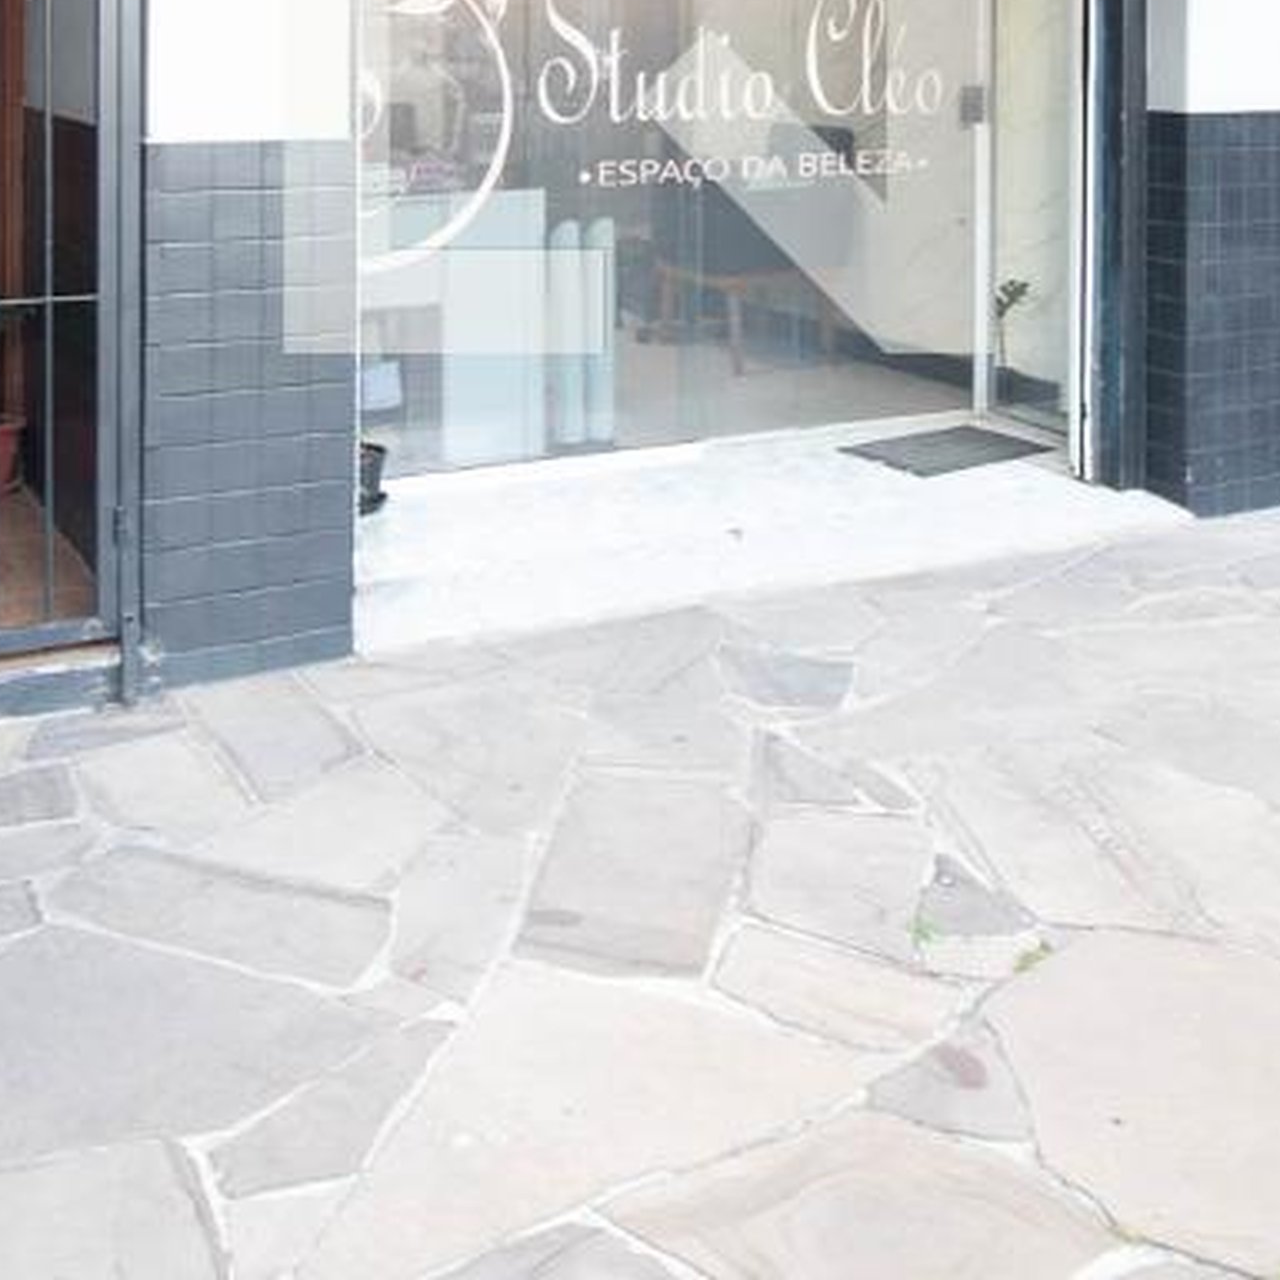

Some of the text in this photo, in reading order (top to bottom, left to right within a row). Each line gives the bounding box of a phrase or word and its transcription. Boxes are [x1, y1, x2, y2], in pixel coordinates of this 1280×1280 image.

[597, 152, 914, 188] ESPAÇO DA BELEZA
